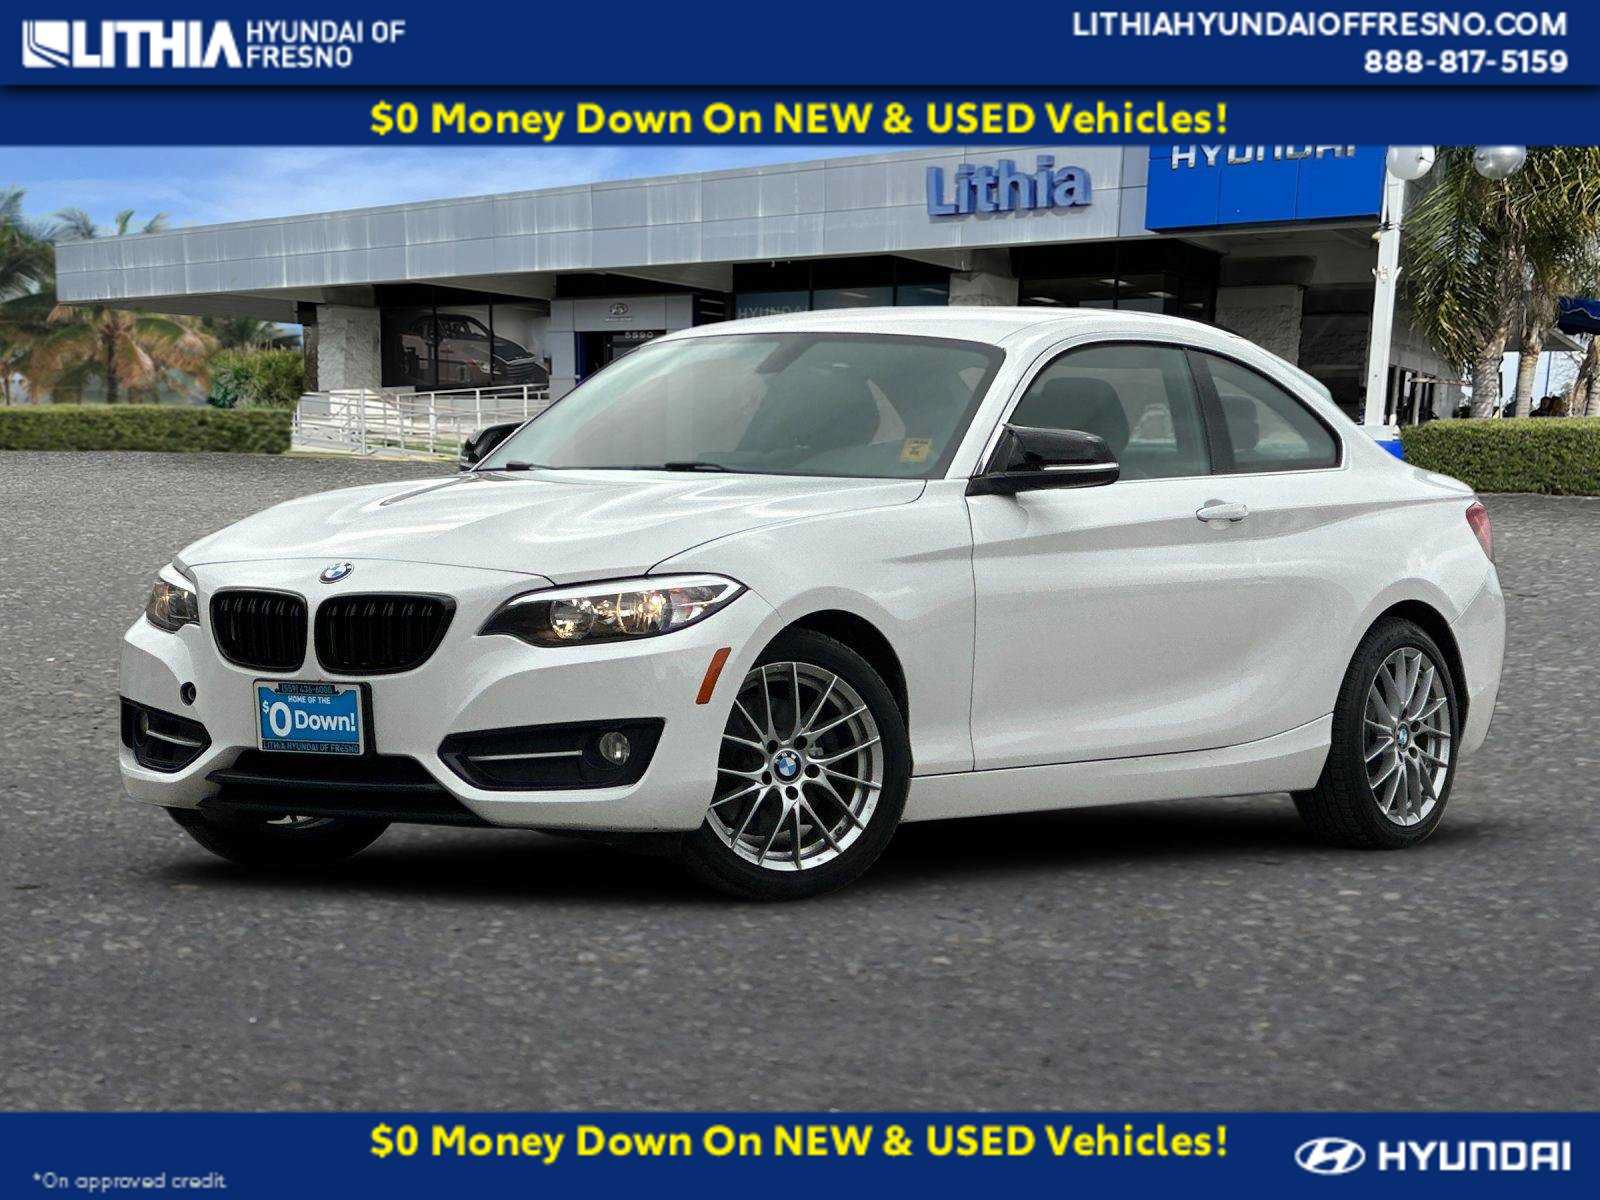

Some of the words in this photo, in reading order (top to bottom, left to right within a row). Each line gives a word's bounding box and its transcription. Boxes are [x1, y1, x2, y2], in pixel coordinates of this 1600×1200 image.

[926, 154, 1093, 216] Lithia
[287, 695, 306, 704] HOME
[308, 696, 316, 704] OF
[317, 696, 331, 705] THE
[294, 709, 356, 732] Down!
